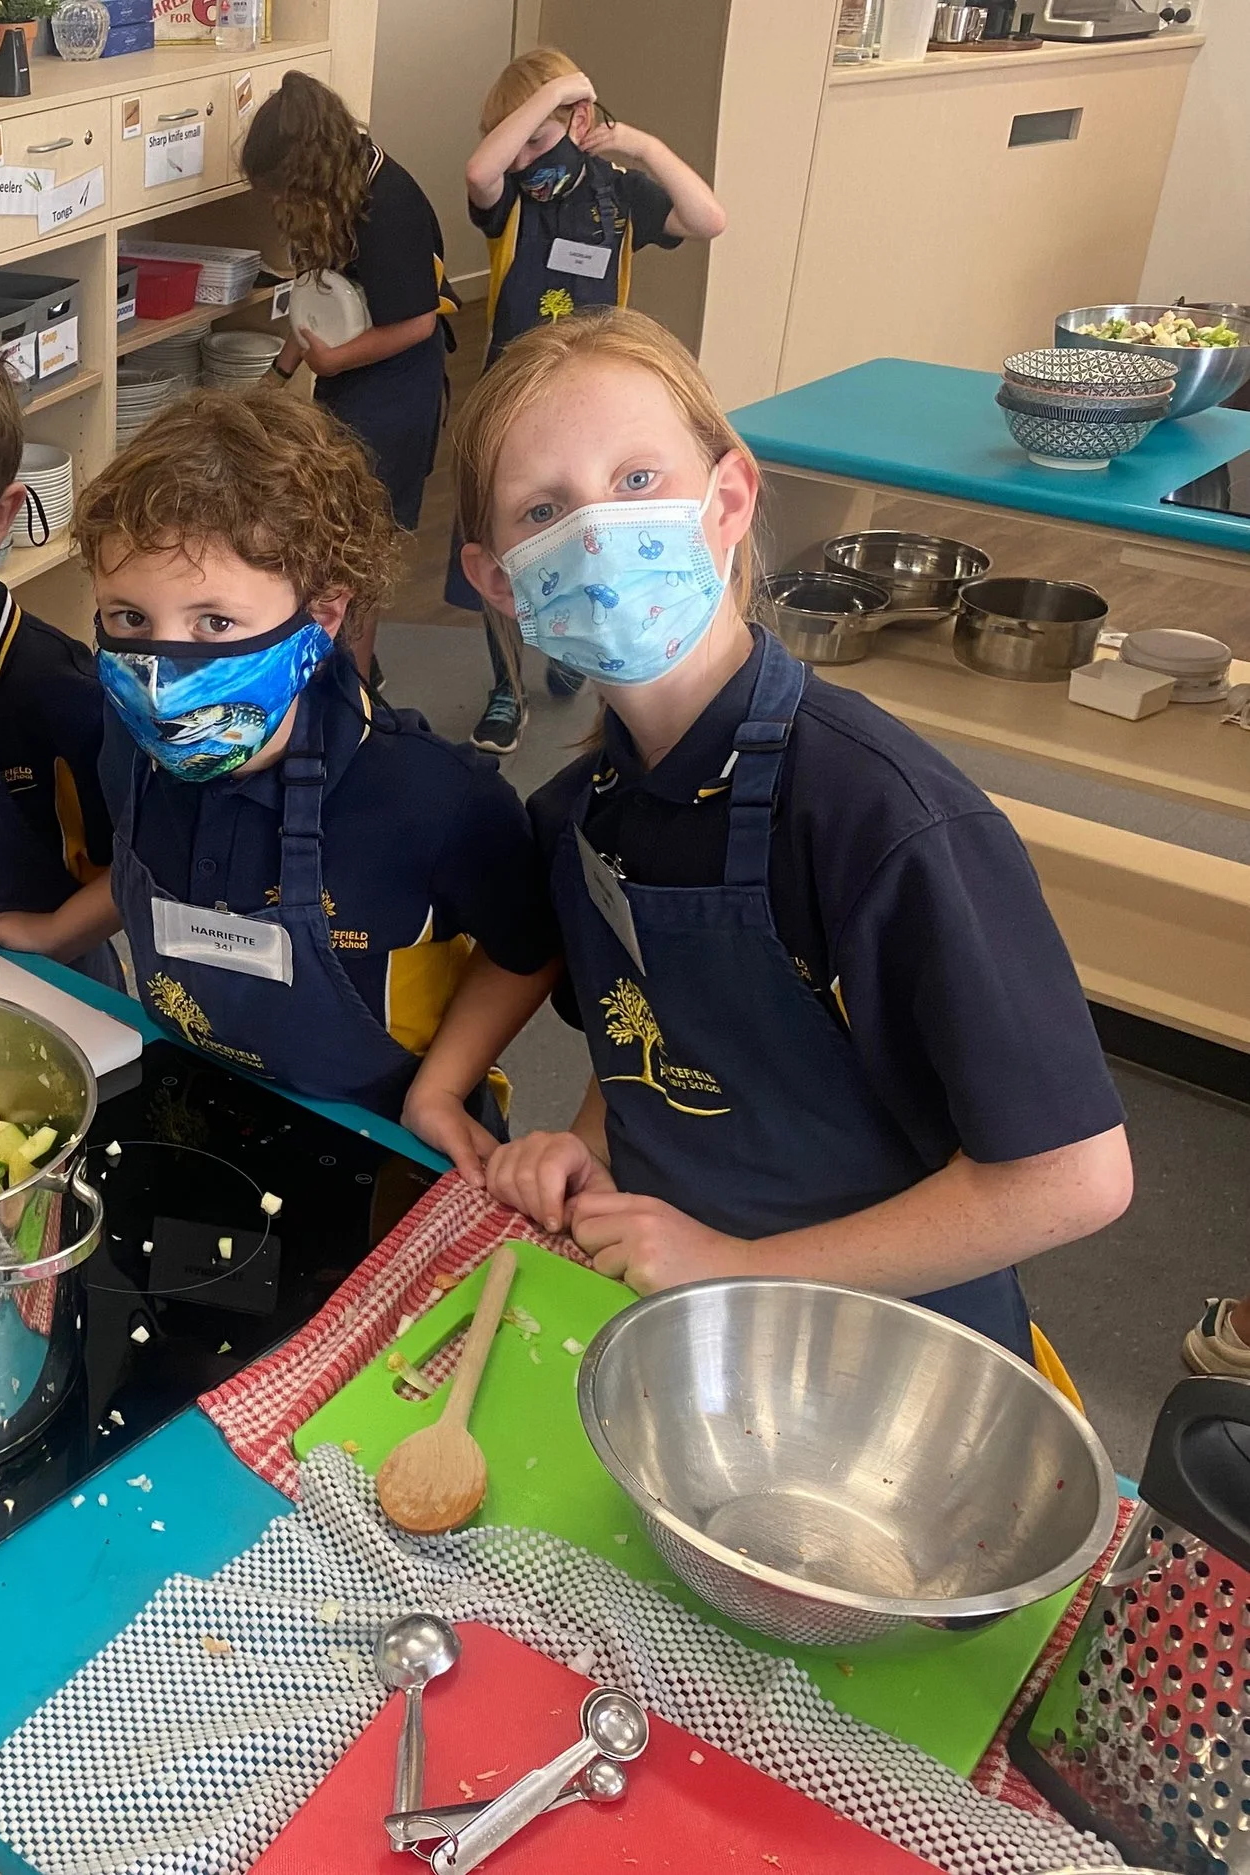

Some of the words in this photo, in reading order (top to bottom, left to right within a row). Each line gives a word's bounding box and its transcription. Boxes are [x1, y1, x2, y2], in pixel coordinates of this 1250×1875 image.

[170, 13, 191, 23] FOR
[149, 135, 167, 148] Sharp
[168, 130, 183, 143] knife
[184, 125, 201, 139] small
[52, 205, 73, 222] Tongs
[191, 924, 255, 946] HARRIETTE
[330, 929, 369, 940] CEFIELD
[339, 939, 368, 949] School
